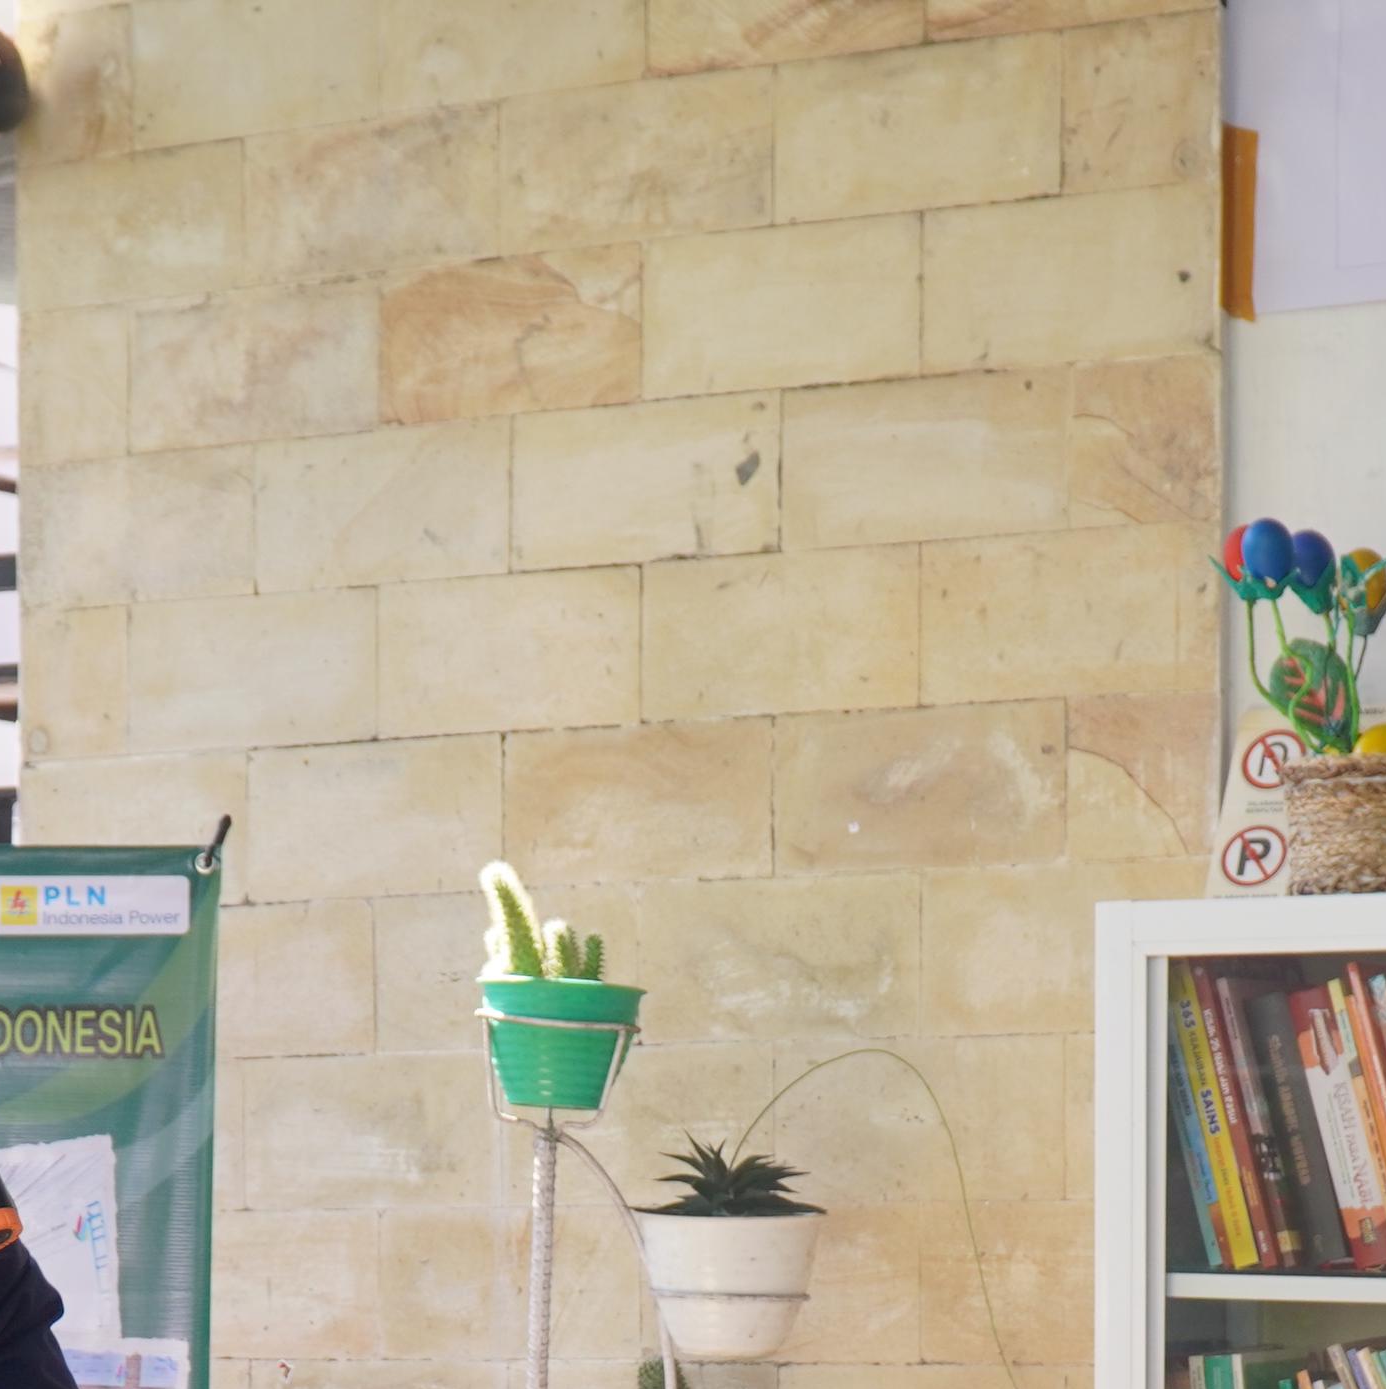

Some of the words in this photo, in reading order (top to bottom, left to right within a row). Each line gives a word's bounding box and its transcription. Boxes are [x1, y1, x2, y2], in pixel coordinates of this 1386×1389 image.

[43, 885, 106, 906] PLN
[42, 911, 123, 926] Indonesia
[128, 910, 180, 925] Power
[1177, 998, 1196, 1029] 365
[1199, 1088, 1221, 1135] SAINS
